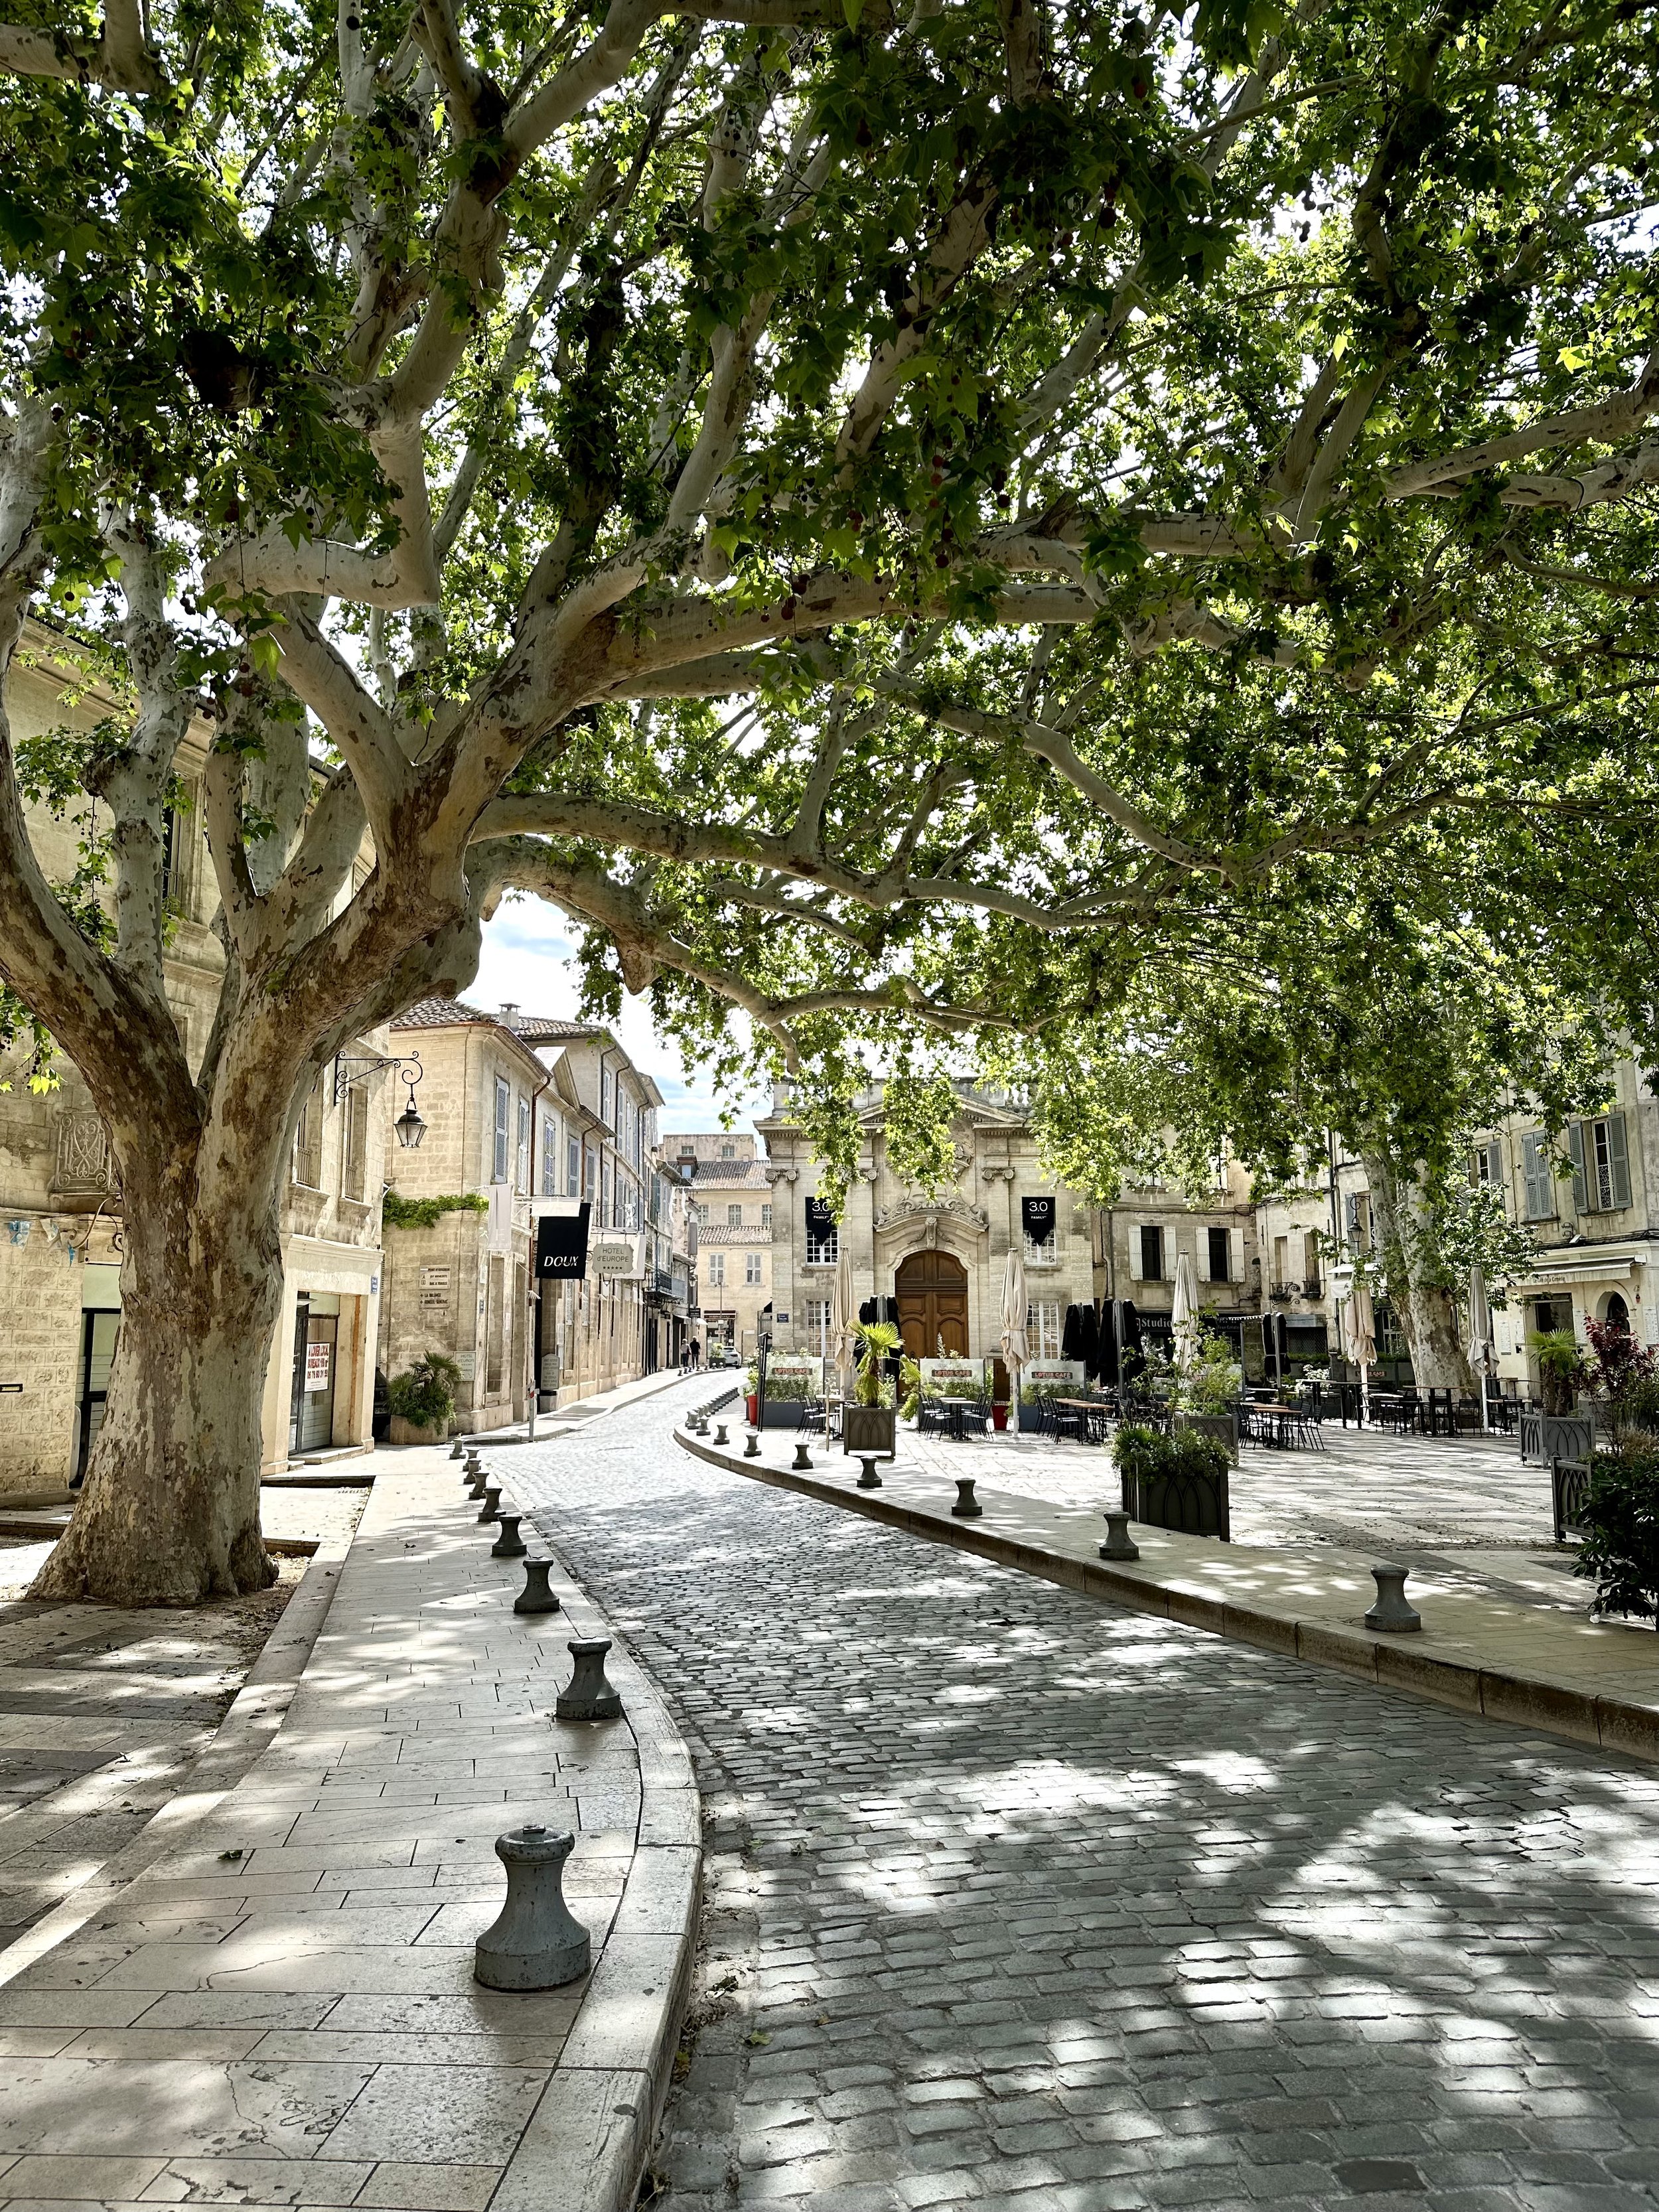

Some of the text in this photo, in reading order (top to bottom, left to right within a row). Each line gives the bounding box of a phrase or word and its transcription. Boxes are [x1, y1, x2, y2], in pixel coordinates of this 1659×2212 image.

[1029, 1201, 1048, 1212] 3.0
[543, 1256, 579, 1267] DOUX
[1141, 1317, 1172, 1327] Studio
